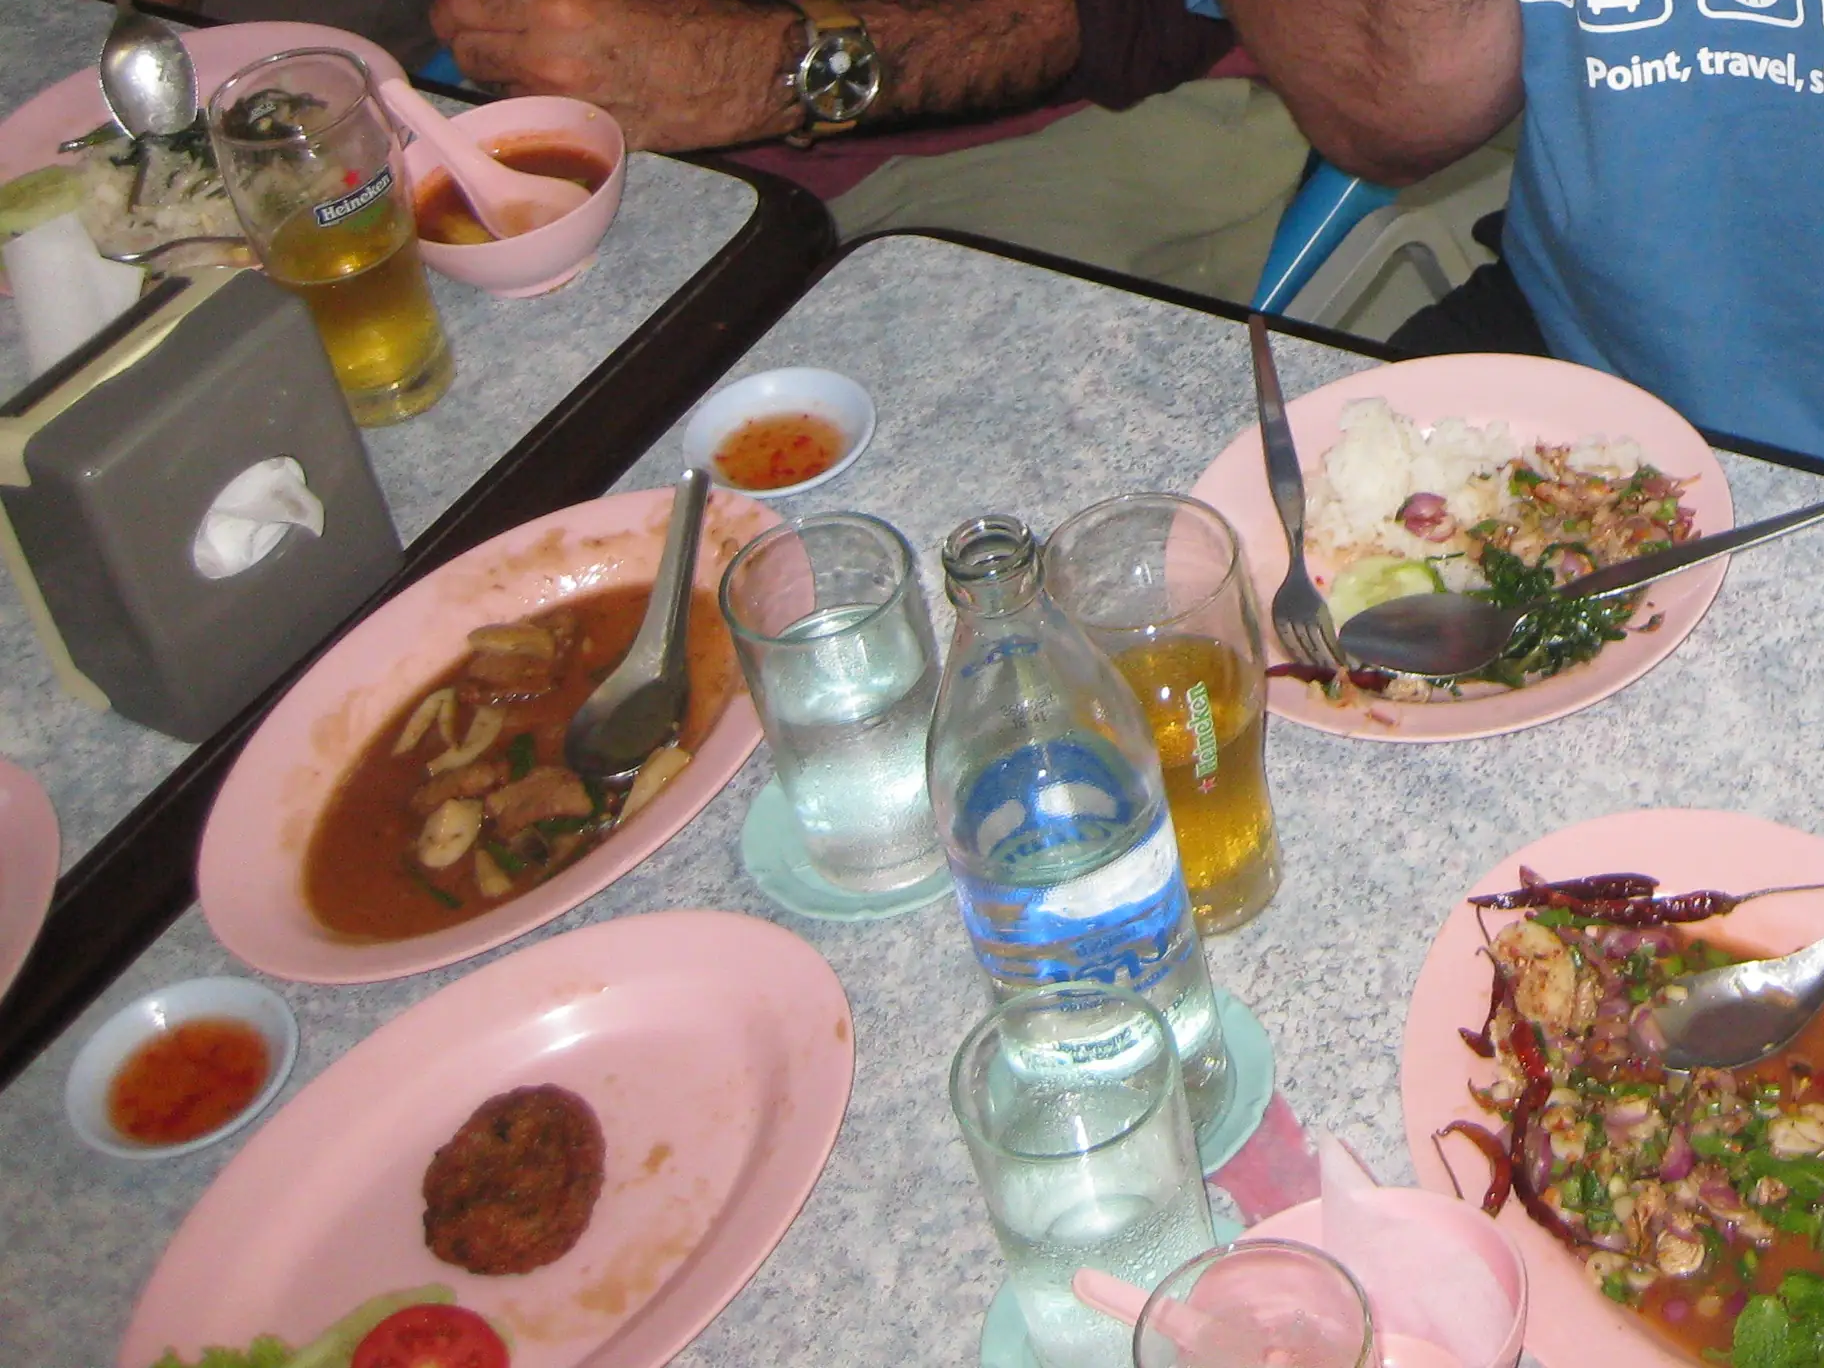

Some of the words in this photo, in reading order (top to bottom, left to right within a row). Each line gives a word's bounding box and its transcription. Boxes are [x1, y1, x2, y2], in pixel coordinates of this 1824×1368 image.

[1586, 50, 1692, 90] Point,
[1696, 46, 1804, 92] travel,
[321, 174, 391, 221] Heineken
[1186, 681, 1218, 779] Heineken
